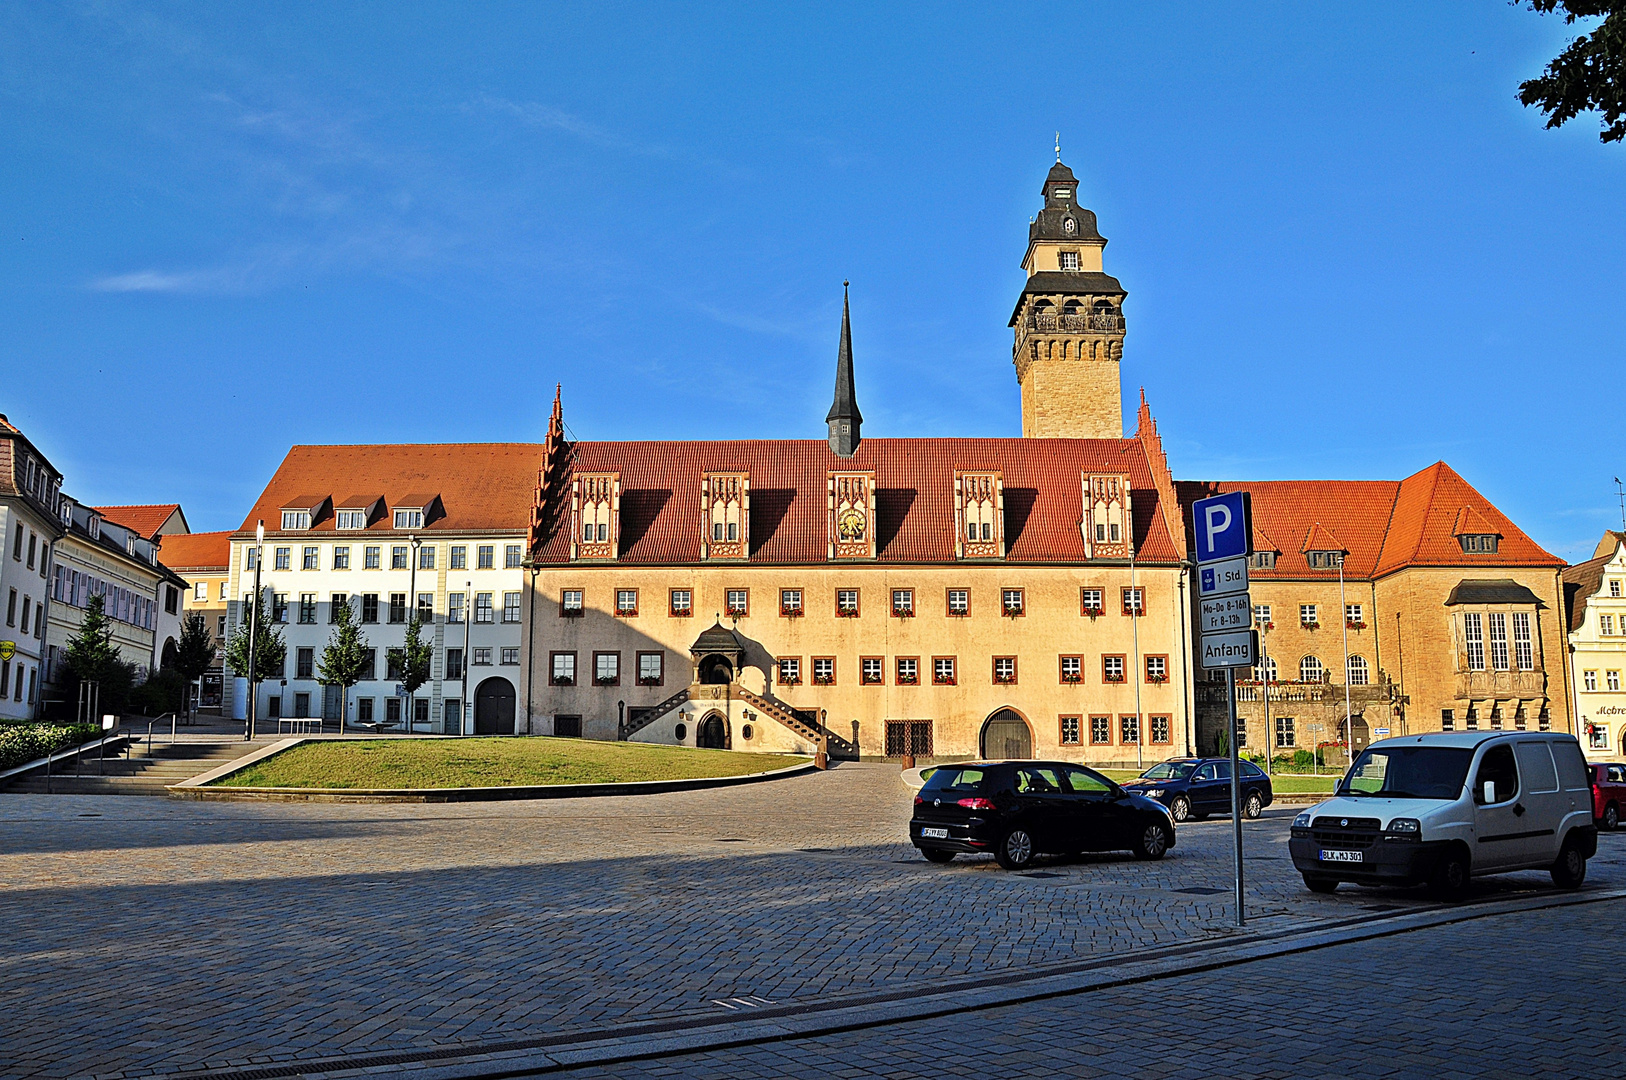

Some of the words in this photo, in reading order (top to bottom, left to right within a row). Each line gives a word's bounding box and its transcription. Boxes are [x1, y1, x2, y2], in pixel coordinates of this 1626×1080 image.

[1205, 504, 1232, 552] P
[1217, 573, 1221, 583] 1
[1225, 570, 1243, 582] Std.
[1203, 602, 1224, 614] Mo-Do
[1227, 600, 1247, 611] 8-16h
[1211, 617, 1218, 627] Fr
[1220, 614, 1240, 626] 8-13h
[1205, 643, 1248, 658] Anfang
